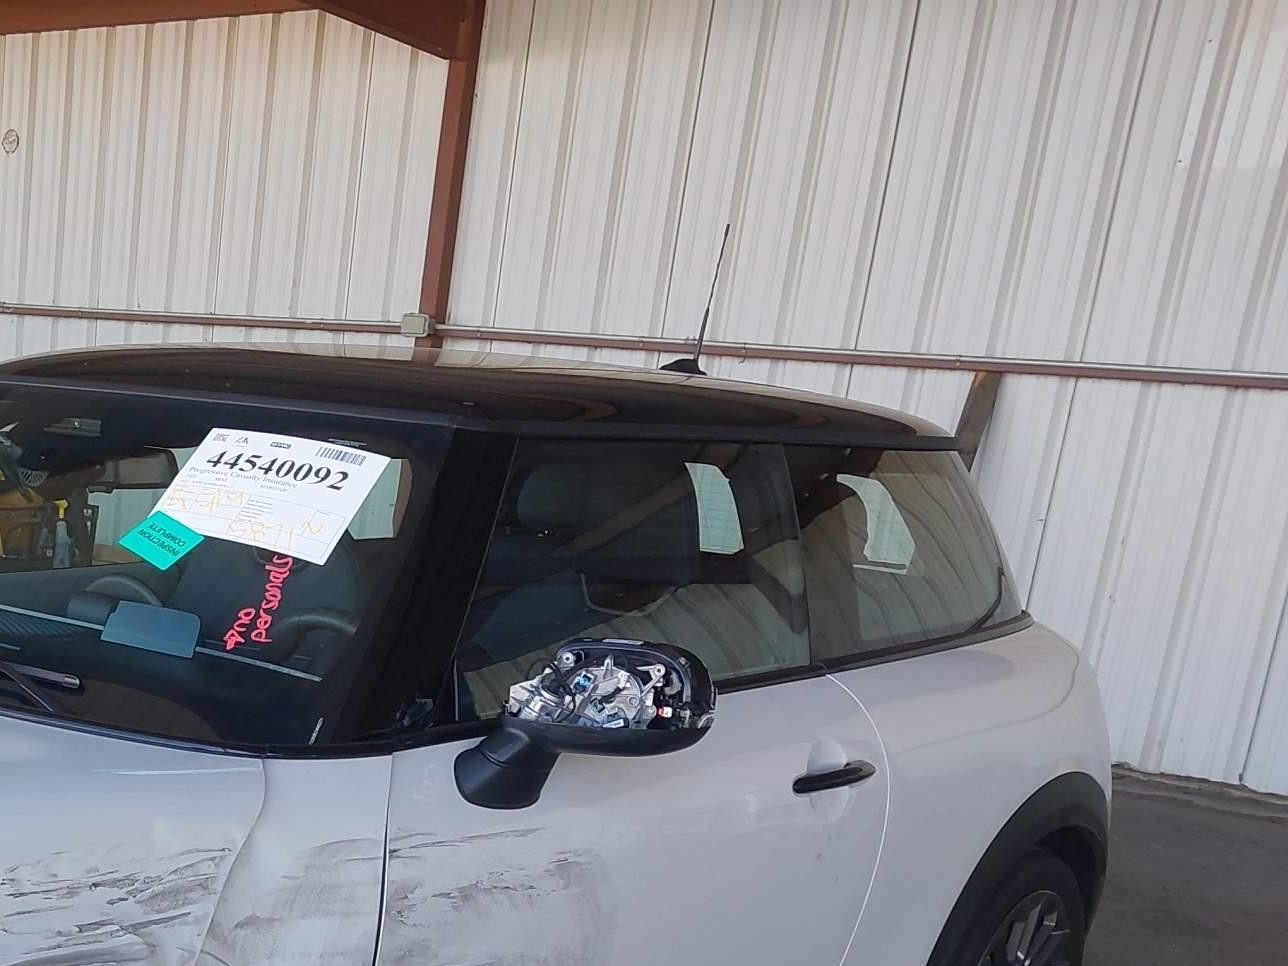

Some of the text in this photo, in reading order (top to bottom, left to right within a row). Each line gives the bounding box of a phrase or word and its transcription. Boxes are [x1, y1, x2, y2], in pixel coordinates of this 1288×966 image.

[206, 450, 349, 491] 44540092
[137, 529, 181, 556] INSPECTION
[148, 522, 186, 547] COMPLETE
